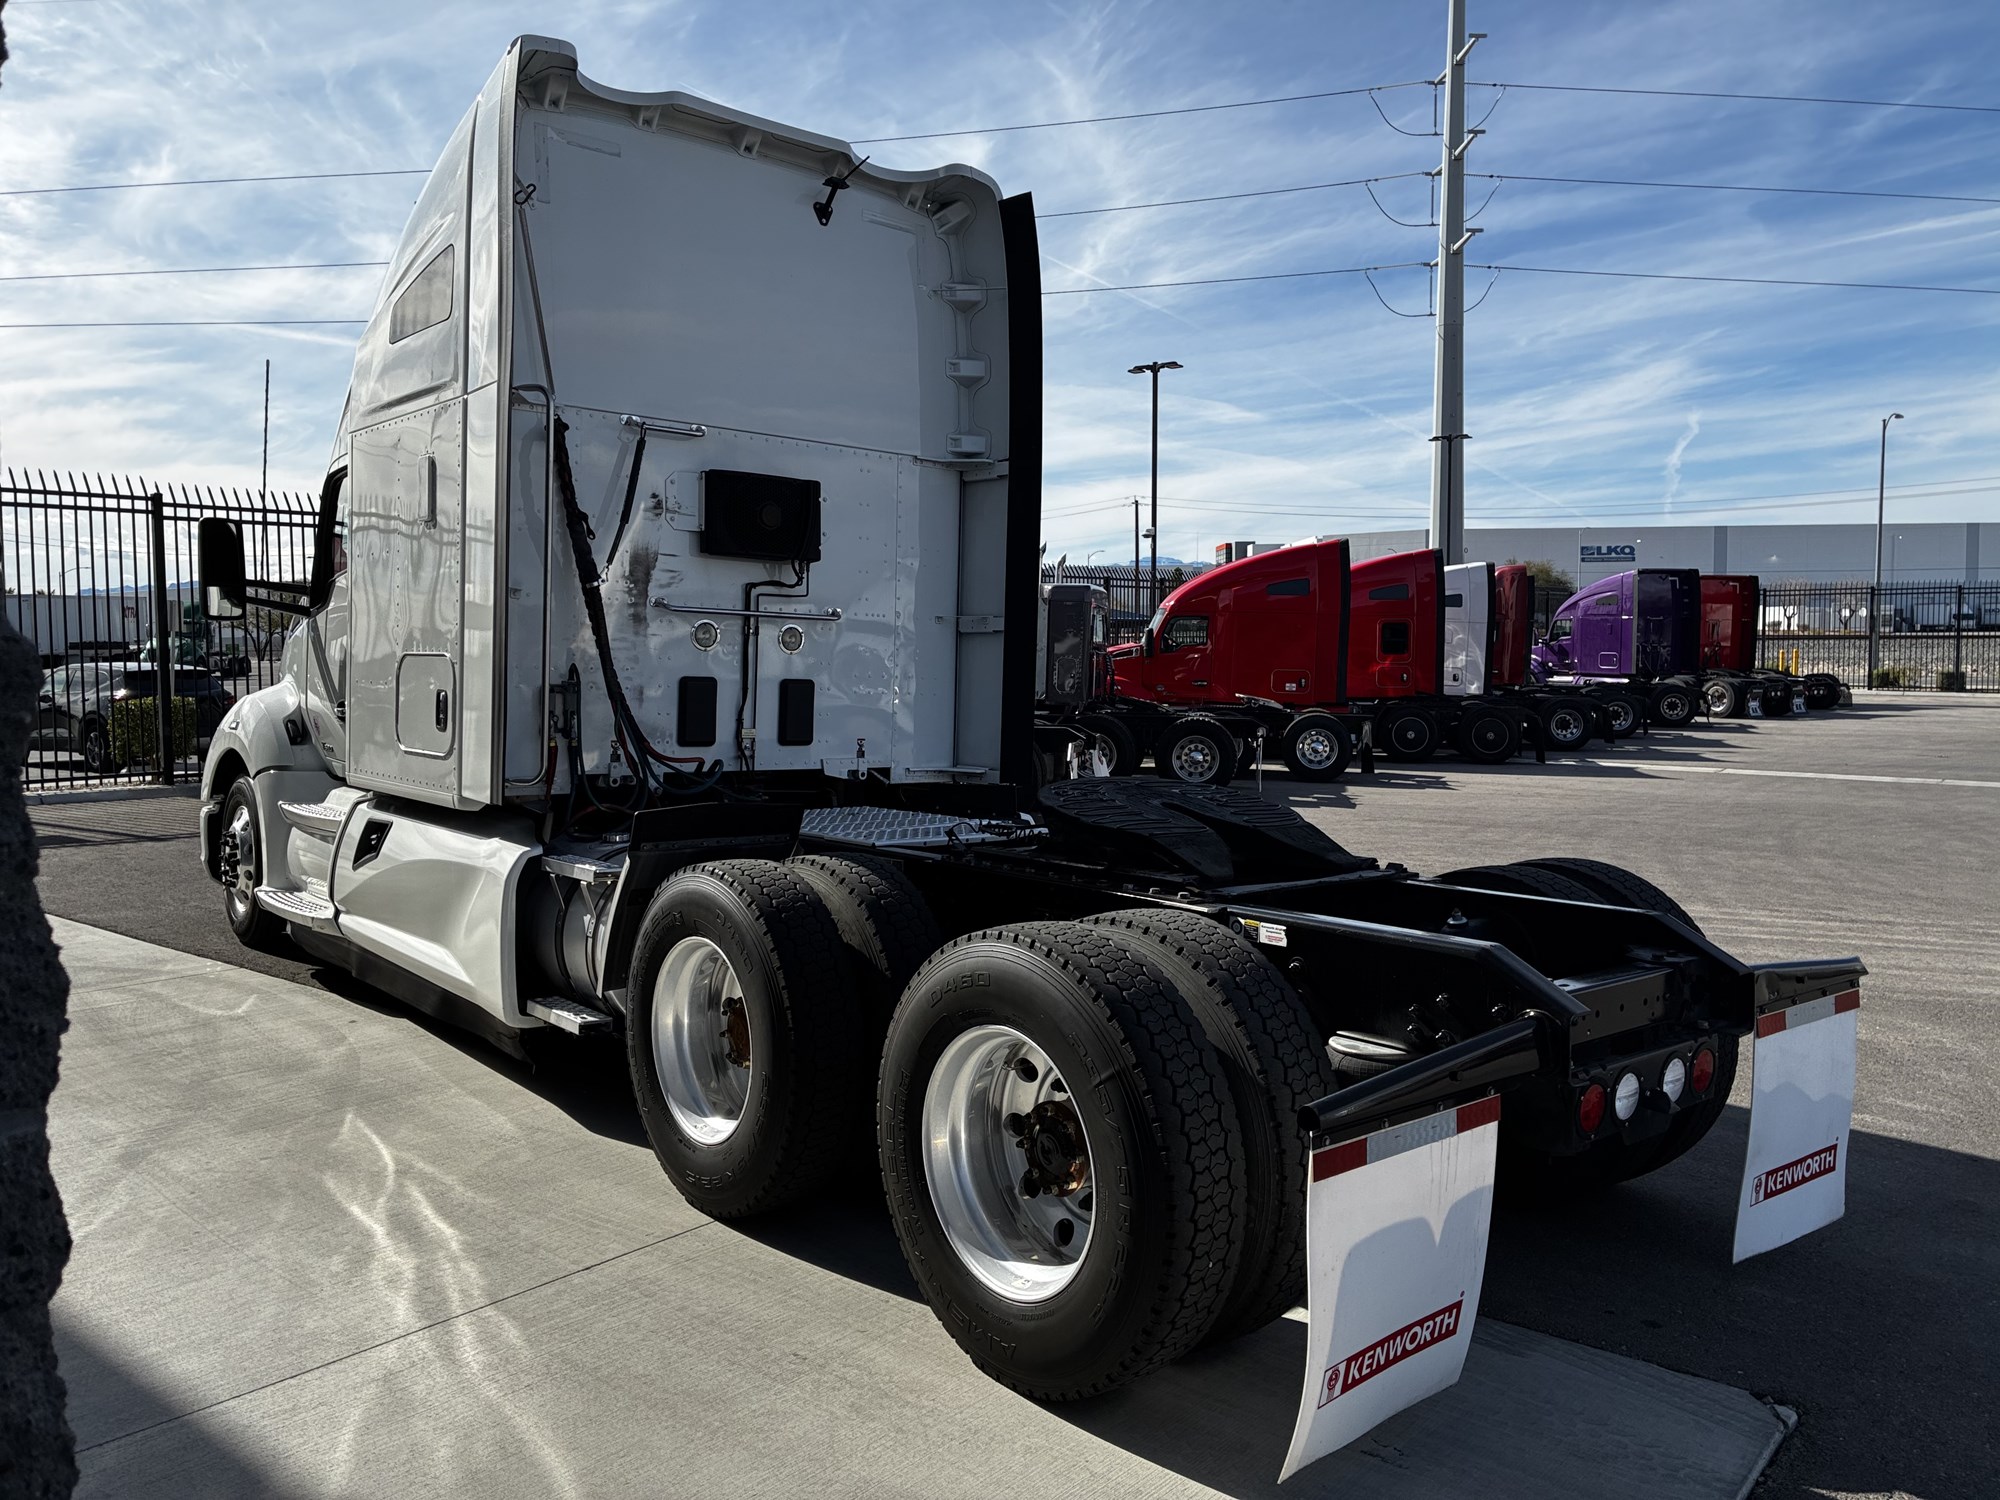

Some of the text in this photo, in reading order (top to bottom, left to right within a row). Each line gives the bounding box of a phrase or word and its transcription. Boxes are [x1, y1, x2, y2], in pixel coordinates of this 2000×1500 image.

[1596, 545, 1636, 556] LKQ
[929, 971, 991, 1008] D460
[1066, 1031, 1132, 1329] 295/75R22.5
[1767, 1149, 1835, 1193] KENWORTH
[1347, 1308, 1457, 1385] KENWORTH
